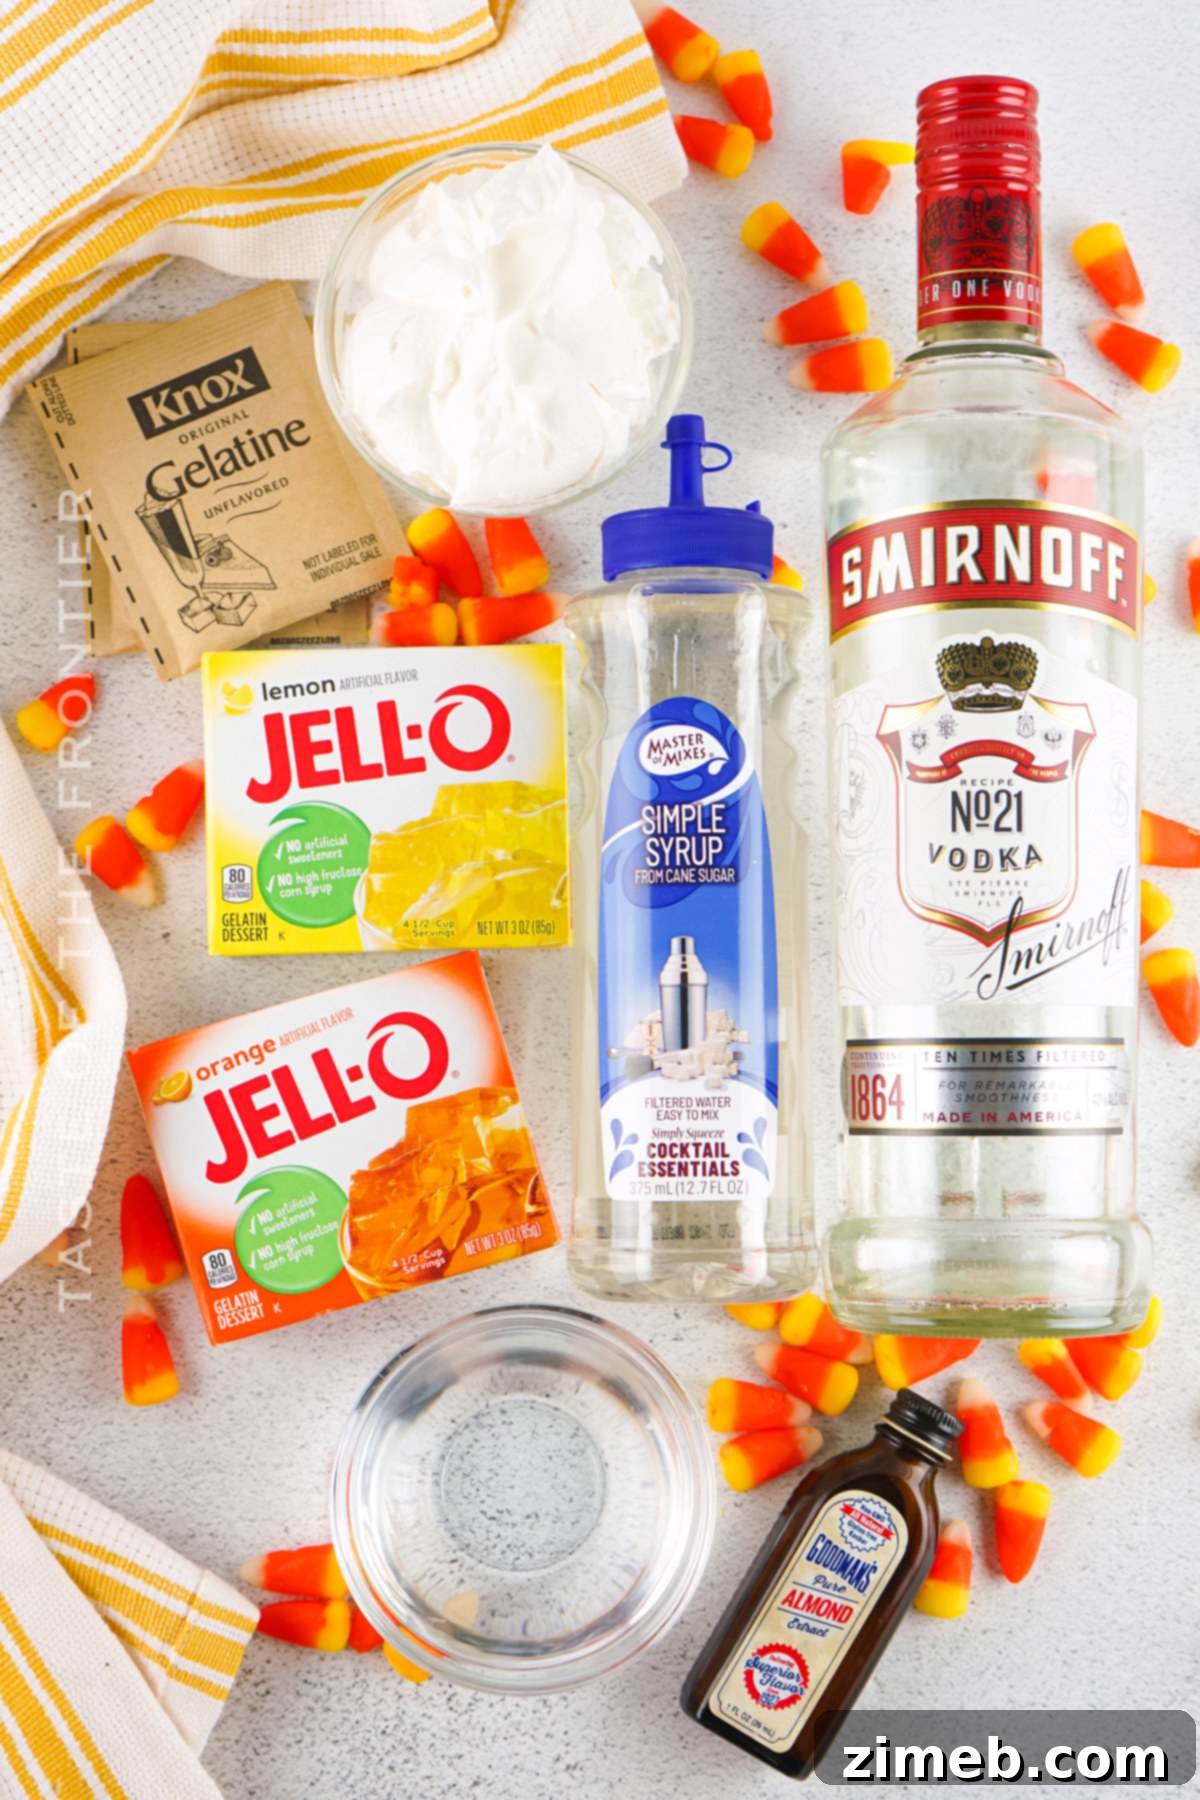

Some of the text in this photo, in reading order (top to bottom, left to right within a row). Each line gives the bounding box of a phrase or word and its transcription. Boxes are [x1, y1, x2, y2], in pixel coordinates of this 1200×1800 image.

[952, 279, 989, 298] ONE
[142, 357, 256, 429] Knox
[178, 409, 250, 445] ORIGINAL
[145, 419, 311, 501] Gelatine
[203, 476, 289, 520] UNFLAVORED
[302, 533, 378, 570] NOT LABELED FOR
[309, 546, 382, 582] INDIVIDUAL SALE
[842, 524, 1126, 609] SMIRNOFF
[261, 669, 418, 701] lemon ARTIFICIAL FLAVOR
[246, 684, 511, 804] JELL-O
[647, 733, 703, 759] MASTER
[663, 747, 706, 767] MIXES
[960, 778, 1014, 787] RECIPE
[641, 804, 726, 835] SIMPLE
[286, 834, 348, 853] NO artificial
[645, 836, 724, 867] SYRUP
[288, 849, 343, 865] sweeteners
[928, 843, 1043, 872] VODKA
[229, 868, 245, 883] 80
[277, 866, 363, 887] NO high fructose
[634, 868, 736, 884] FROM CANE SUGAR
[280, 882, 333, 898] corn syrup
[222, 912, 267, 927] GELATIN
[477, 919, 556, 936] NET WT 3 OZ (85g)
[222, 927, 268, 942] DESSERT
[278, 931, 286, 941] K
[412, 929, 455, 938] Servings
[966, 866, 1131, 1000] Smirnoff
[196, 1007, 354, 1082] orange ARTIFICIAL FLAVOR
[923, 1050, 1105, 1063] TEN TIMES FILTERED
[938, 1080, 967, 1090] FOR
[203, 1011, 449, 1184] JELL-O
[644, 1096, 732, 1109] FILTERED WATER
[851, 1073, 905, 1121] 1864
[656, 1109, 719, 1121] EASY TO MIX
[922, 1111, 1083, 1123] MADE IN AMERICA
[651, 1127, 726, 1142] Simply Squeeze
[647, 1142, 730, 1159] COCKTAIL
[637, 1160, 740, 1178] ESSENTIALS
[629, 1181, 652, 1195] 375
[655, 1181, 673, 1195] mL
[710, 1180, 724, 1195] FL
[727, 1180, 749, 1196] OZ)
[257, 1191, 318, 1226] NO artificial
[263, 1208, 316, 1236] sweeteners
[257, 1221, 339, 1260] NO high fructose
[464, 1221, 542, 1256] NET WT 3 OZ (85g)
[209, 1252, 227, 1270] 80
[263, 1244, 314, 1271] corn syrup
[392, 1259, 399, 1268] 4
[402, 1258, 446, 1274] Servings
[213, 1289, 259, 1314] GELATIN
[272, 1303, 282, 1313] K
[217, 1303, 264, 1330] DESSERT
[812, 1574, 847, 1594] Pure
[781, 1588, 854, 1624] ALMOND
[787, 1617, 829, 1638] Extract
[744, 1656, 802, 1683] Superior
[759, 1673, 805, 1696] Flavor
[731, 1705, 739, 1716] FL
[740, 1711, 752, 1723] OZ
